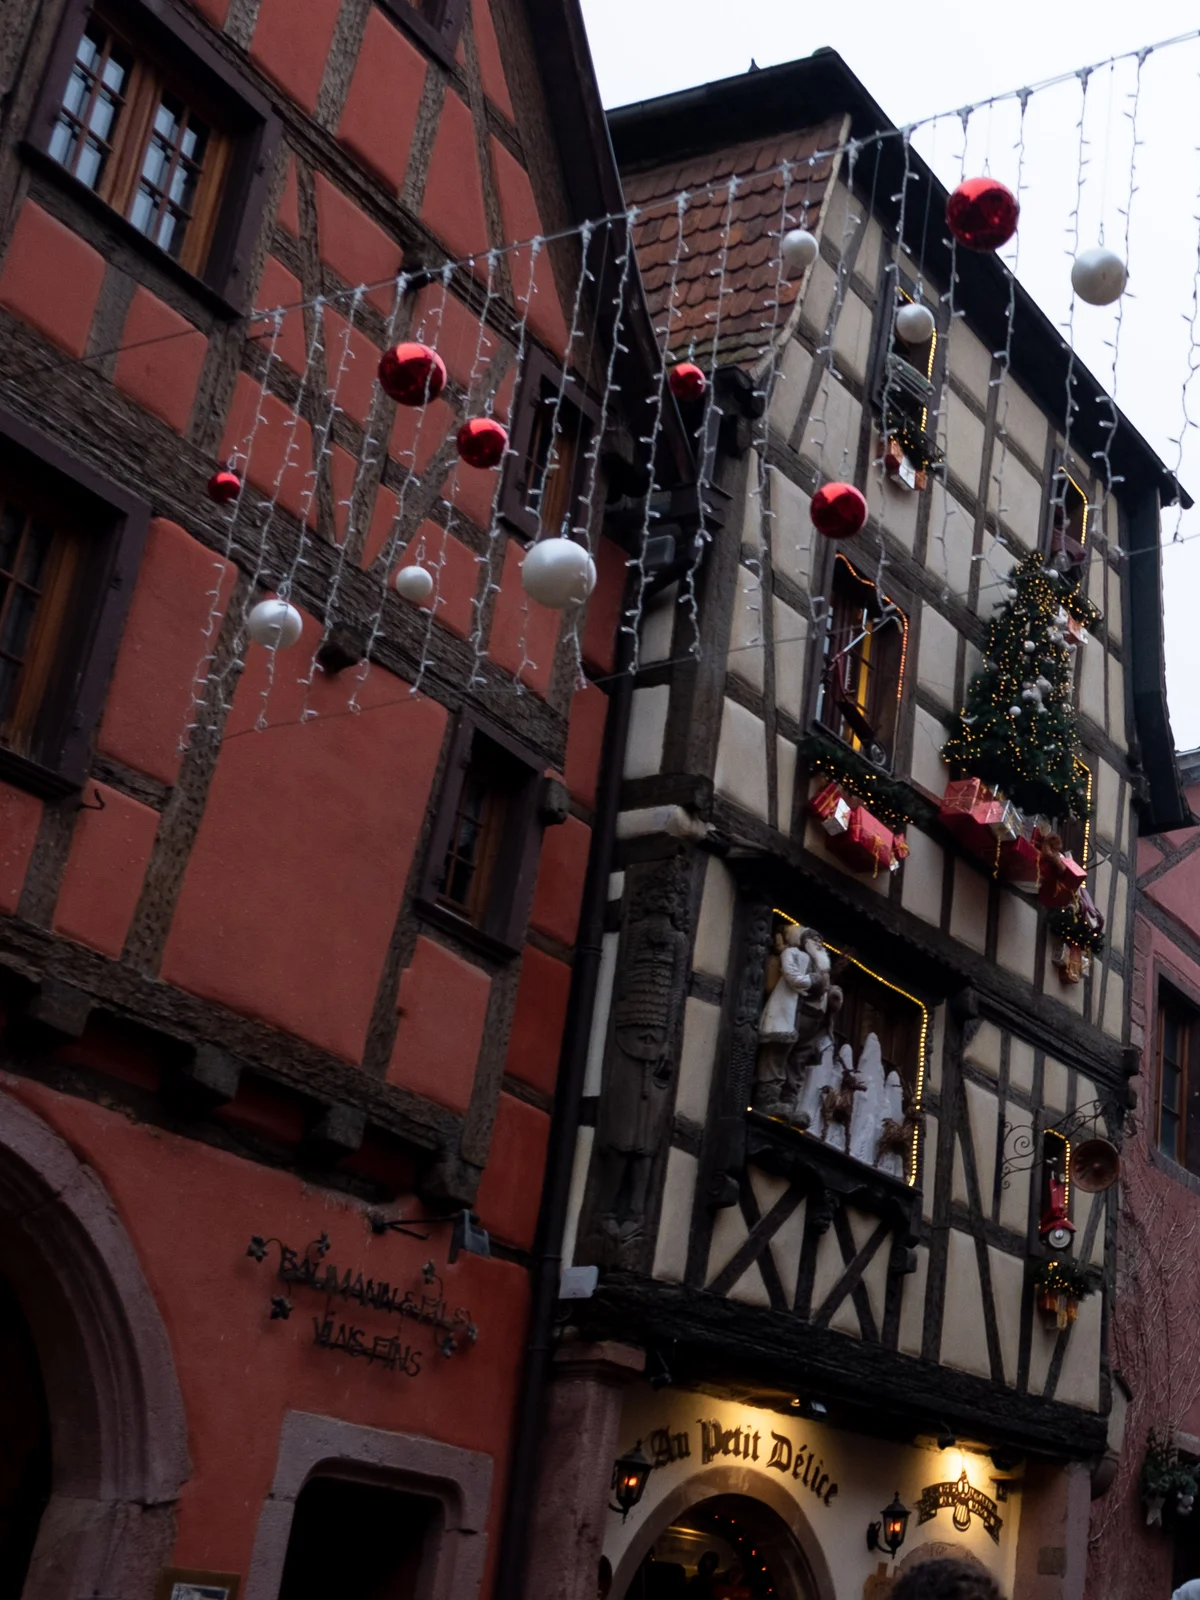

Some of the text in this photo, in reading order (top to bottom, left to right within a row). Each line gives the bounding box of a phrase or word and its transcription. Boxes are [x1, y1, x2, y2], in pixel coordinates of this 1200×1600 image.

[648, 1418, 839, 1506] Au Petit Délice
